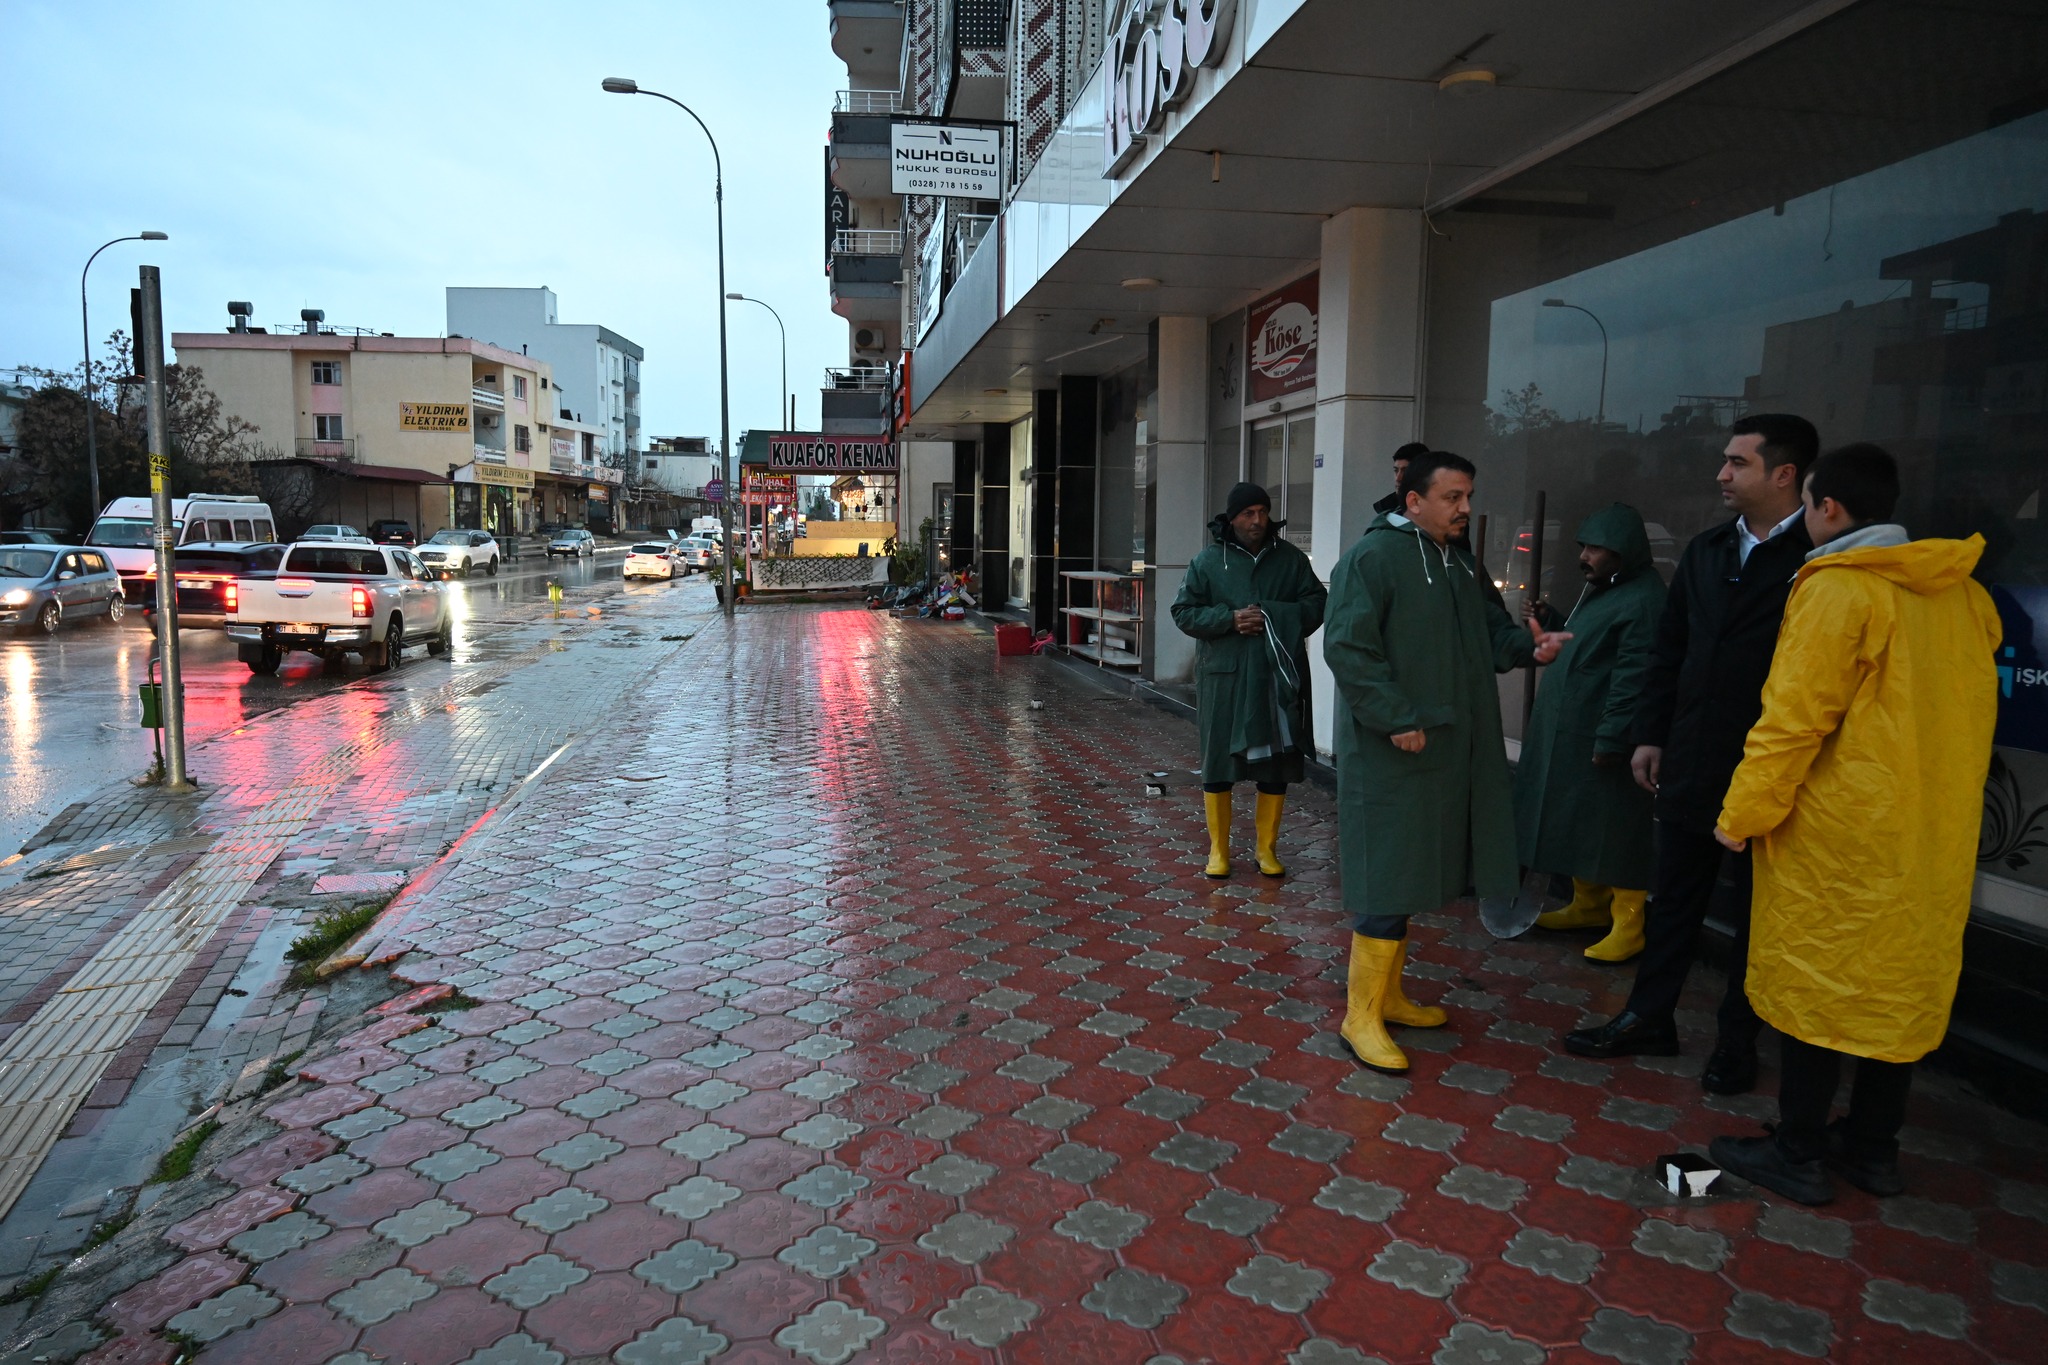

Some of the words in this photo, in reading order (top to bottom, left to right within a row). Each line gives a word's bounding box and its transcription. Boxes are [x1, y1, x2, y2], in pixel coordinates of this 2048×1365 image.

[896, 148, 996, 165] NUHOĞLU
[896, 164, 940, 174] HUKUK
[945, 167, 997, 177] BÜROSU
[909, 179, 937, 189] (0328)
[940, 181, 956, 190] 718
[960, 182, 969, 190] 15
[972, 183, 983, 191] 59
[1264, 325, 1302, 357] Köse
[416, 405, 465, 416] YILDIRIM
[458, 418, 467, 426] 2
[772, 437, 838, 467] KUAFÖR
[841, 443, 897, 468] KENAN
[481, 466, 503, 477] YILDIRIM
[279, 625, 286, 633] 01
[309, 626, 318, 634] 171
